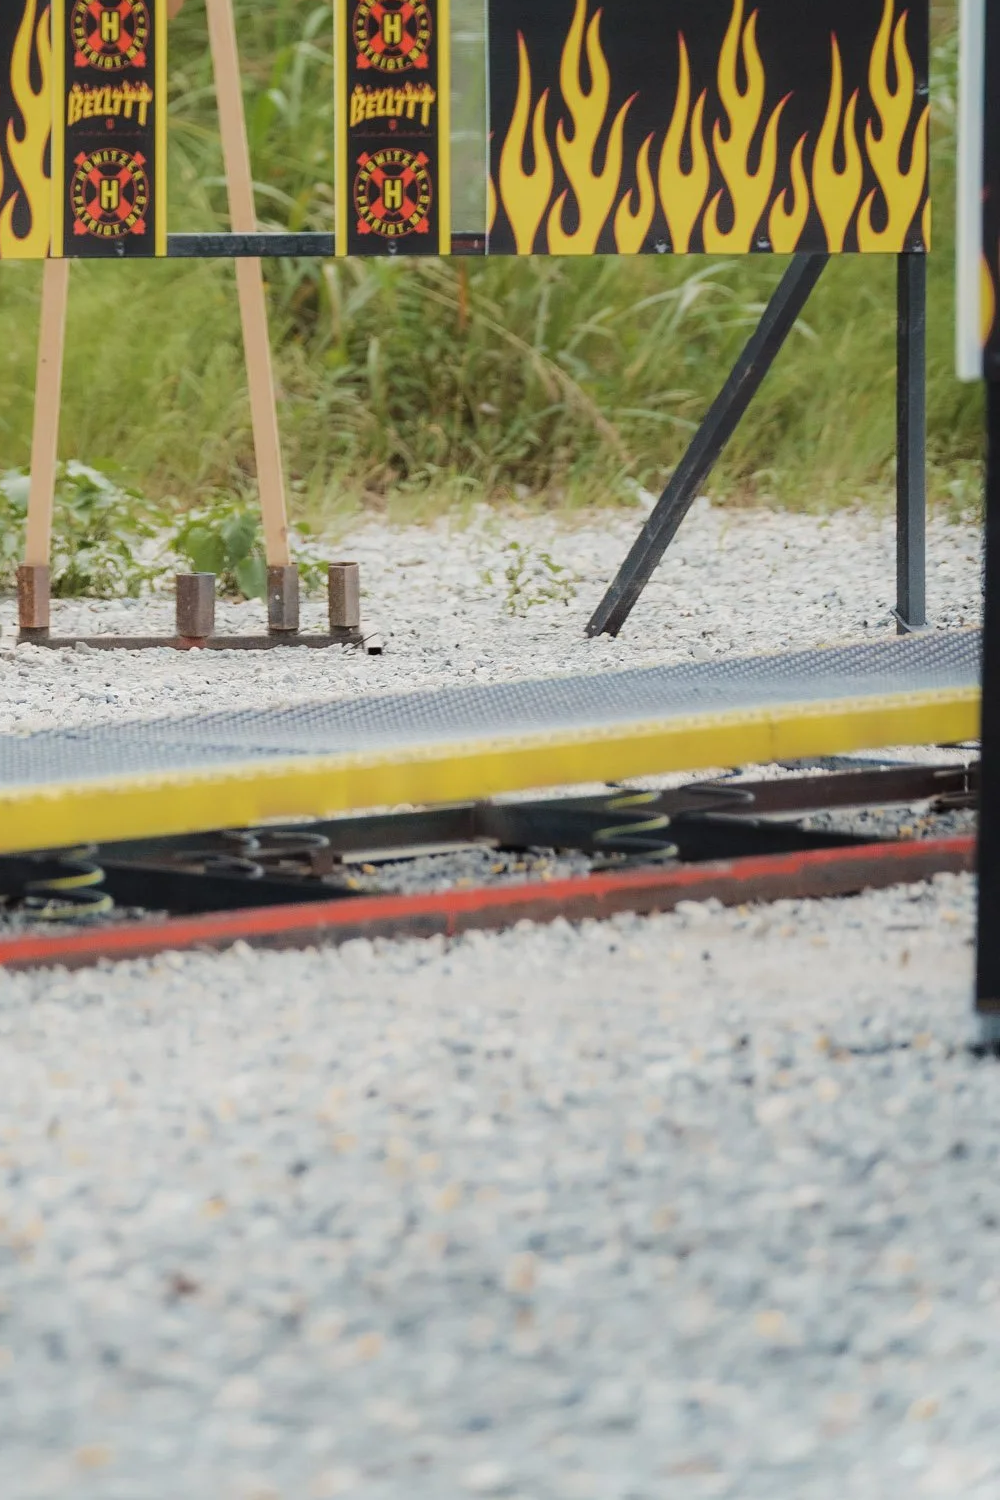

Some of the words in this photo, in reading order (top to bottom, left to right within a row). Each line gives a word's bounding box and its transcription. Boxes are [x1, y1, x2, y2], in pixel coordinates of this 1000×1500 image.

[101, 11, 120, 42] H
[383, 13, 402, 44] H
[100, 179, 119, 209] H
[384, 179, 402, 209] H
